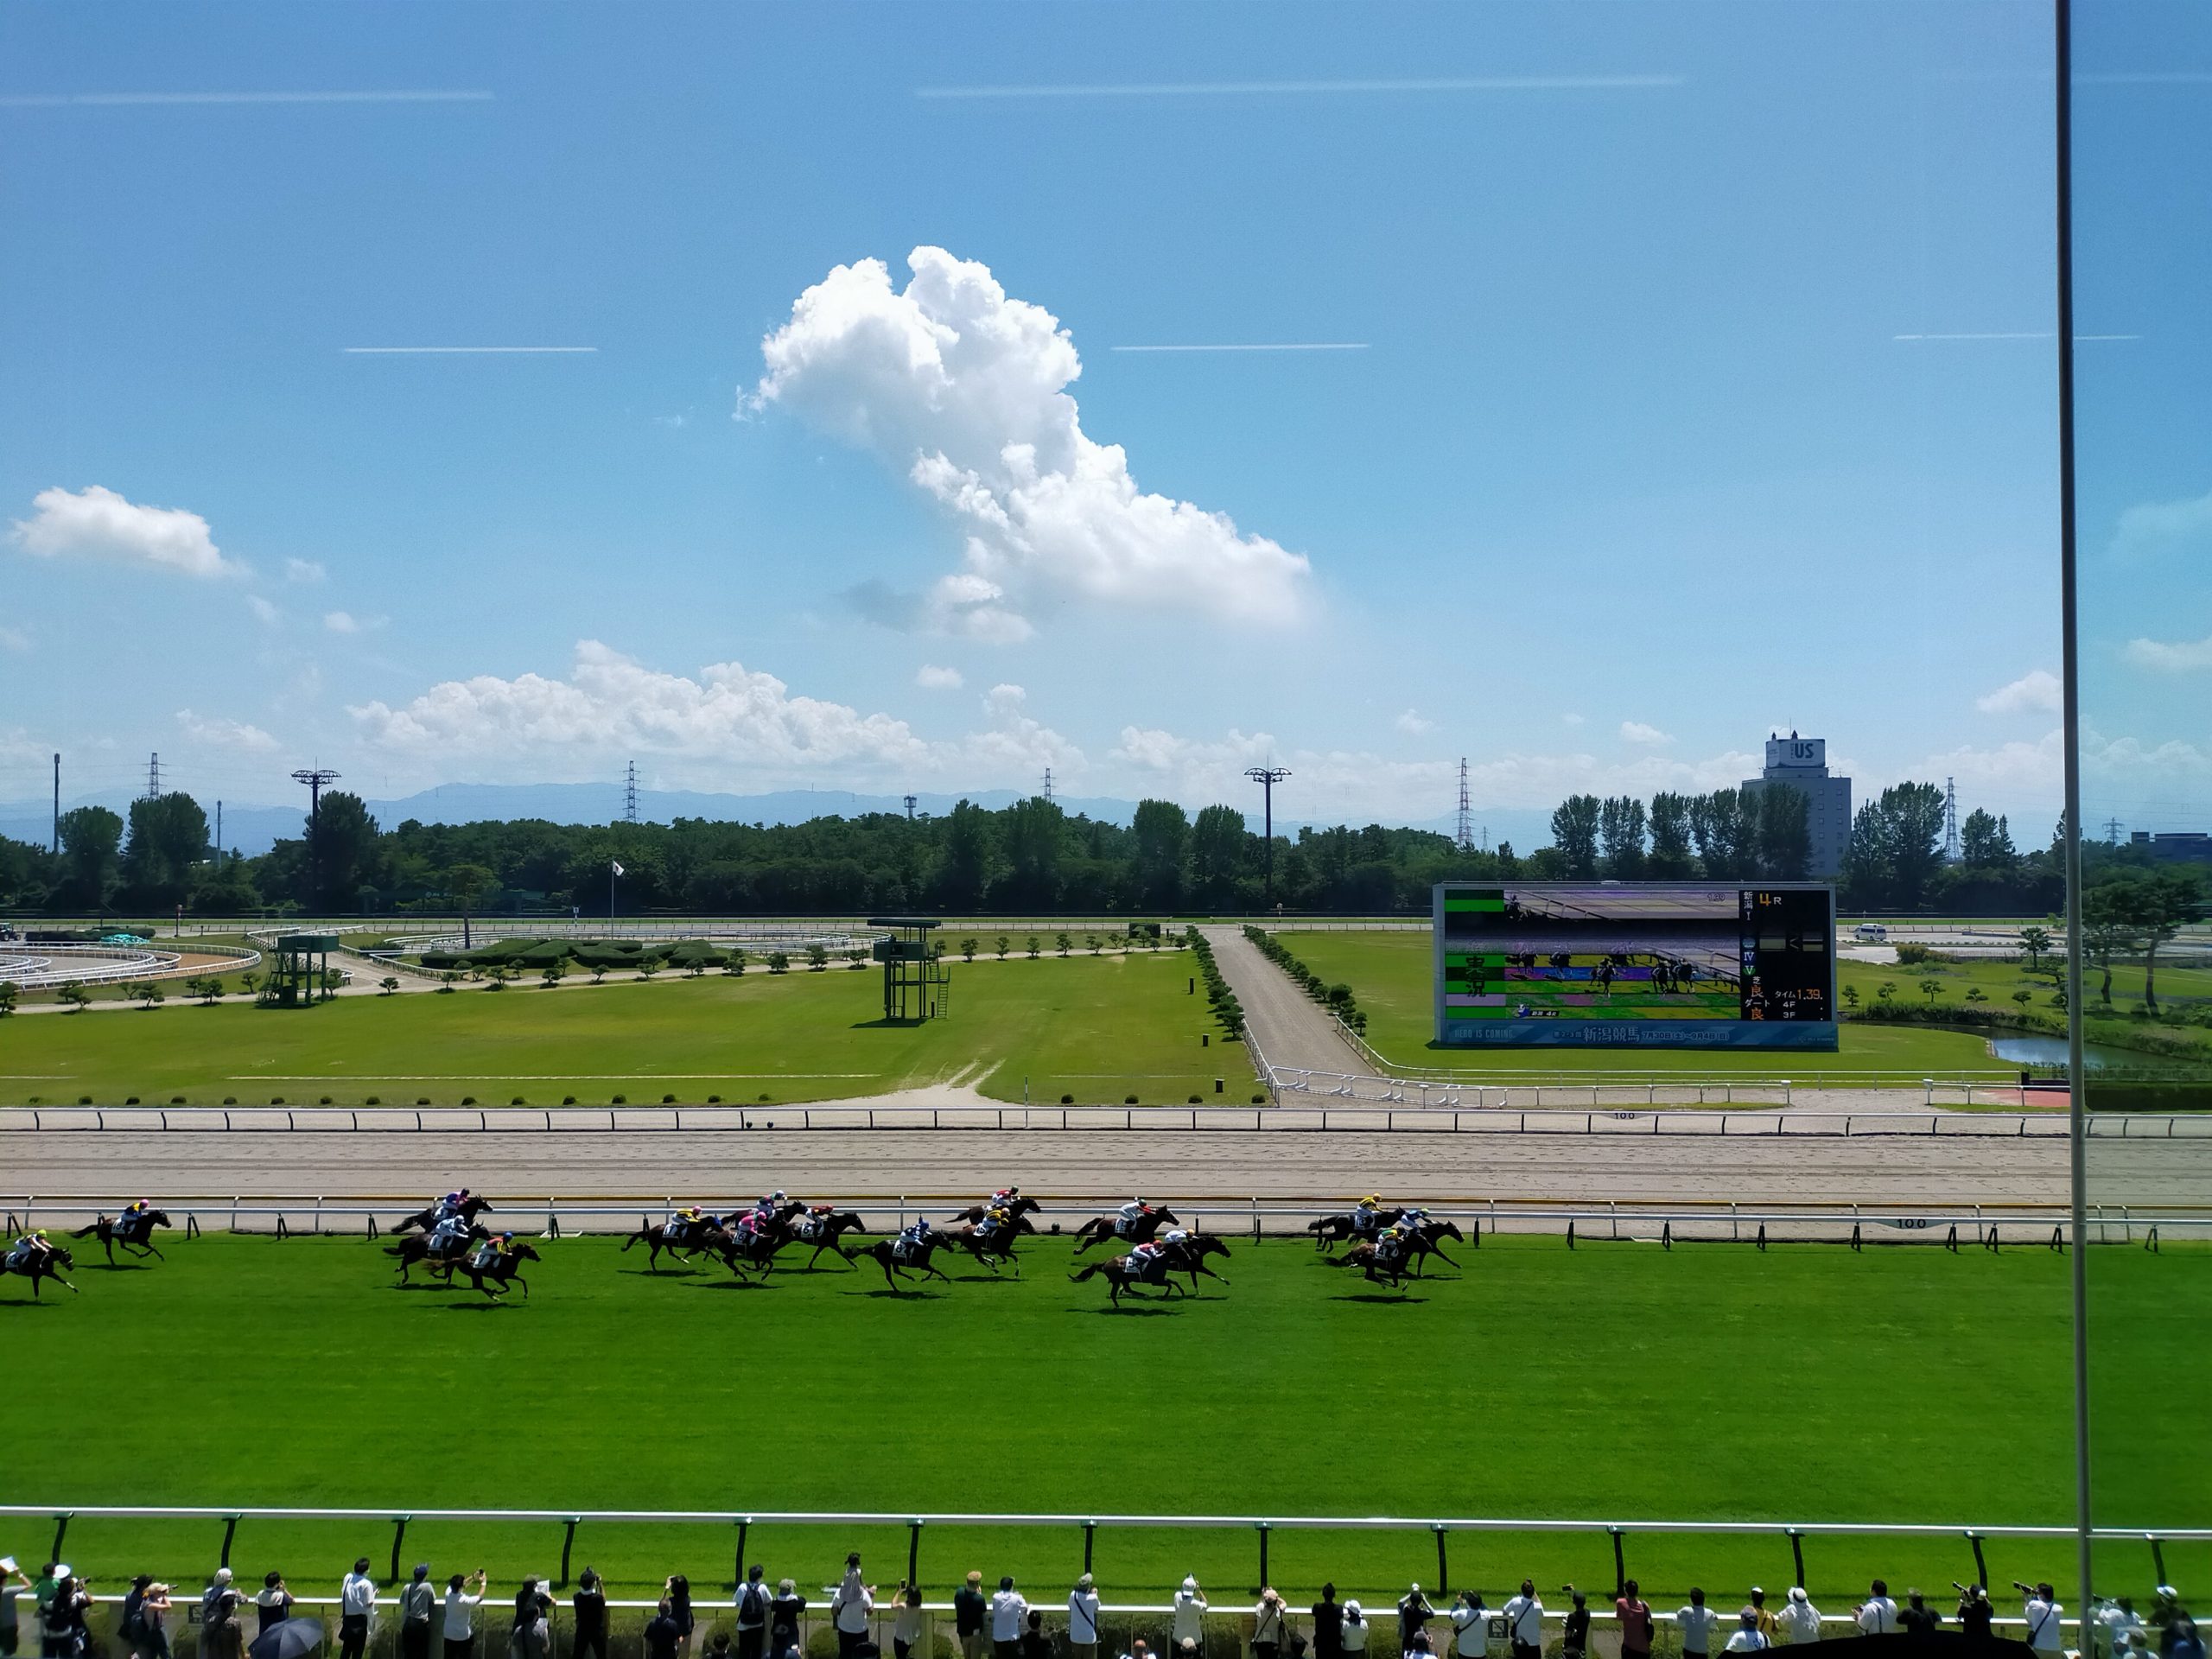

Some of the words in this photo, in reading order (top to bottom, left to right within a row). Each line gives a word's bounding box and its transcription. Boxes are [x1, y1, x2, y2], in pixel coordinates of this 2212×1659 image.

[1795, 743, 1814, 758] US
[1744, 891, 1753, 910] 新潟
[1745, 965, 1754, 975] V
[1751, 984, 1764, 998] 良
[1775, 990, 1796, 999] タイム
[1745, 998, 1770, 1007] ダート
[1751, 1007, 1764, 1020] 良
[1476, 1029, 1483, 1038] IS
[1583, 1027, 1640, 1042] 新潟競馬
[1897, 1218, 1927, 1229] 100
